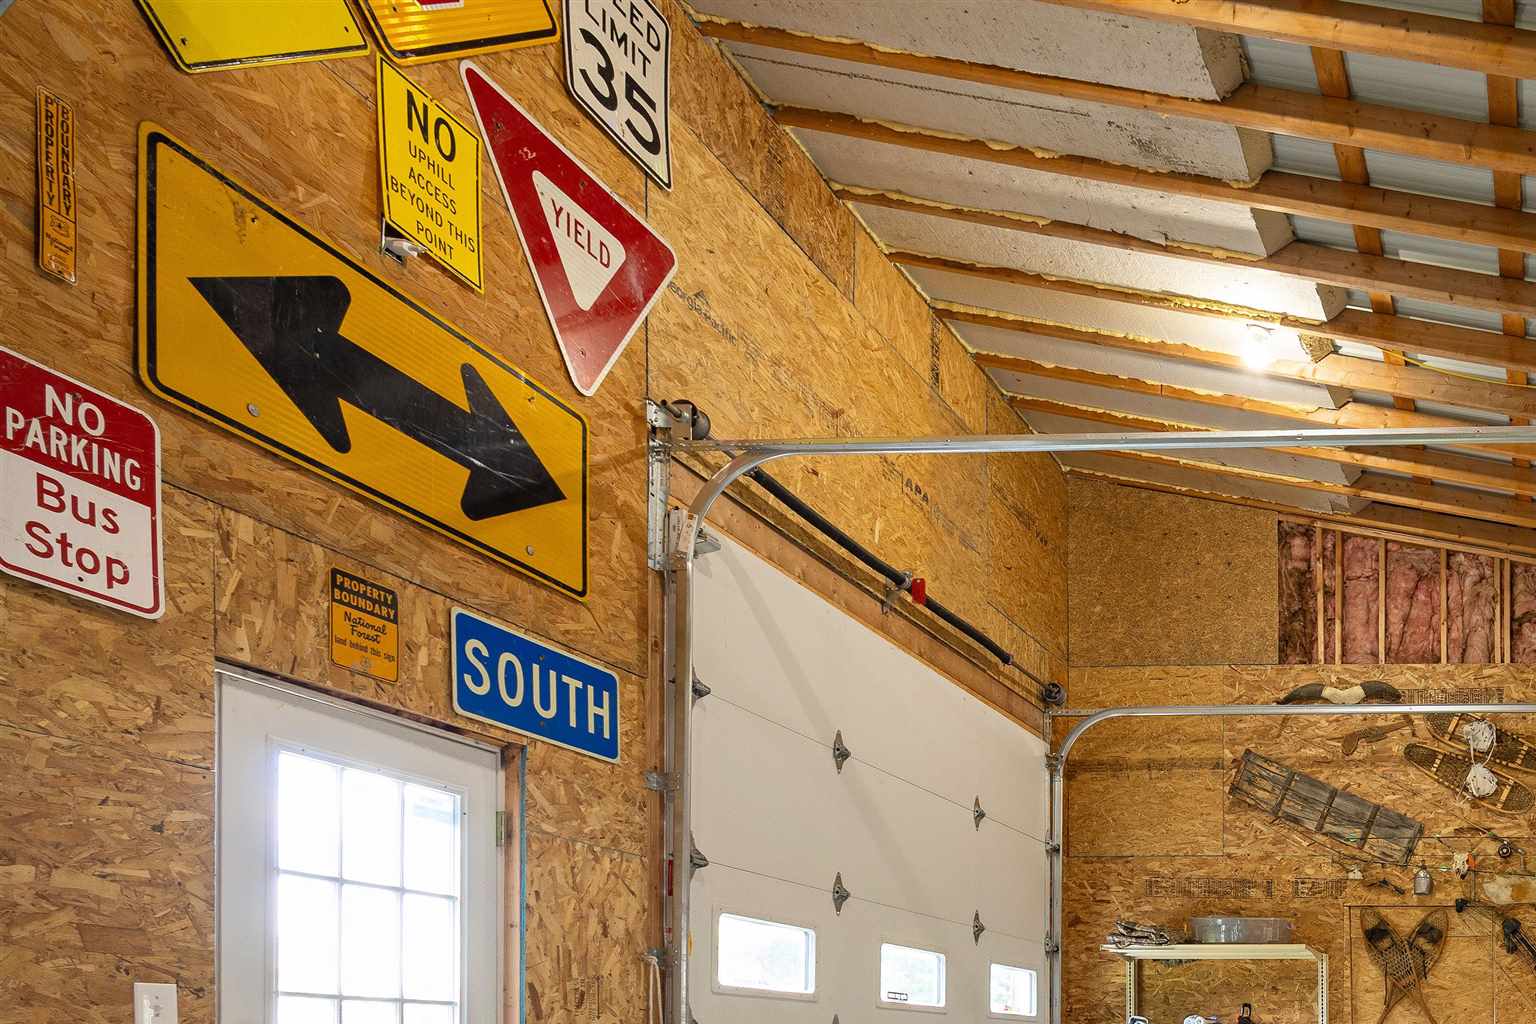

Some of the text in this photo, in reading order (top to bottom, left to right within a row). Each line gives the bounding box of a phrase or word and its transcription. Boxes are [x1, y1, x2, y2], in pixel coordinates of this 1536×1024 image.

[585, 0, 651, 78] LIMIT
[406, 88, 456, 162] NO
[579, 28, 661, 156] 35
[45, 97, 54, 206] PROPERTY
[61, 107, 72, 216] BOUNDARY
[409, 141, 455, 190] UPHILL
[391, 176, 475, 252] BEYOND THIS
[409, 167, 457, 214] ACCESS
[416, 220, 454, 260] POINT
[551, 198, 610, 268] YIELD
[45, 384, 105, 436] NO
[6, 407, 141, 491] PARKING
[36, 472, 120, 534] Bus
[25, 521, 130, 589] Stop
[336, 575, 392, 603] PROPERTY
[335, 588, 395, 619] BOUNDARY
[344, 611, 387, 635] National
[350, 625, 380, 643] Forest
[464, 639, 610, 739] SOUTH
